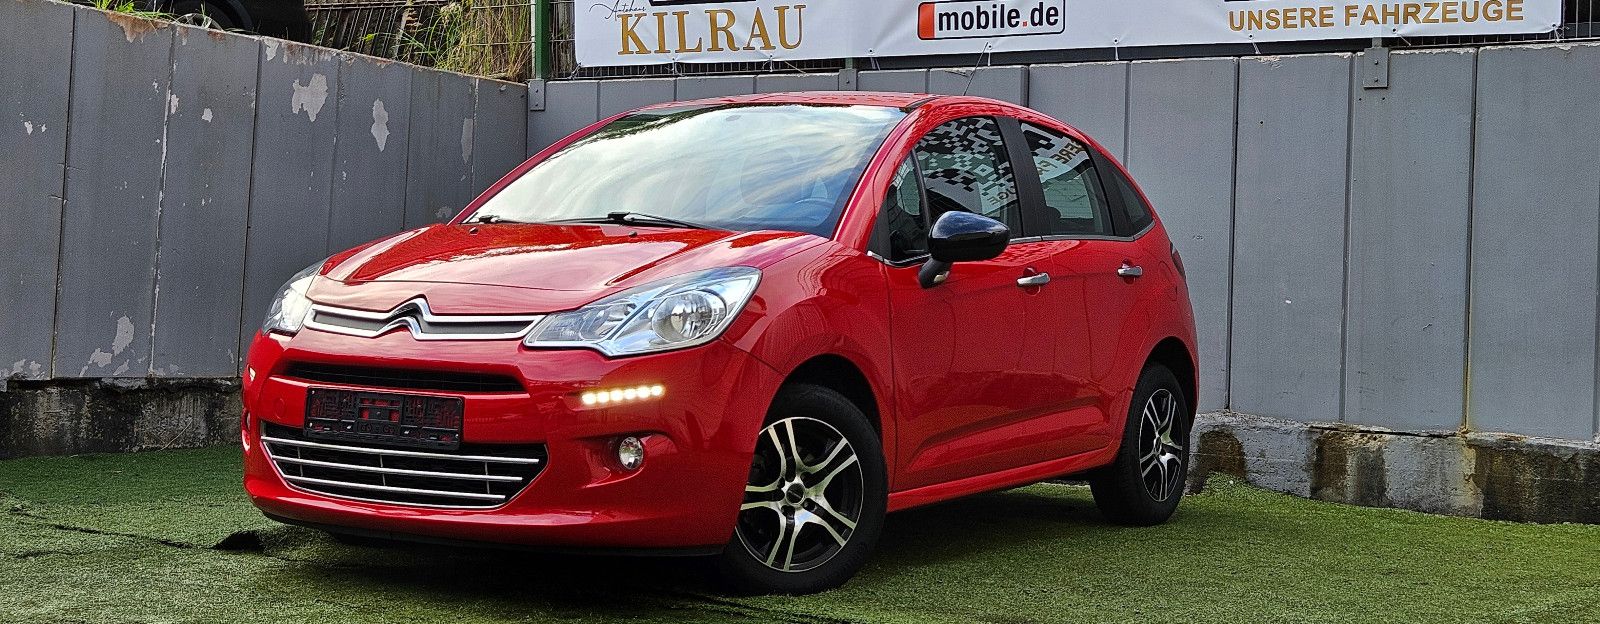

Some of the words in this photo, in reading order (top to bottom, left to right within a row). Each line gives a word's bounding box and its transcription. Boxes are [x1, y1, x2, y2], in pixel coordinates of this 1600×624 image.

[617, 4, 807, 55] KILRAU
[938, 1, 1059, 31] mobile.de
[1228, 6, 1335, 32] UNSERE
[1344, 0, 1525, 26] FAHRZEUGE
